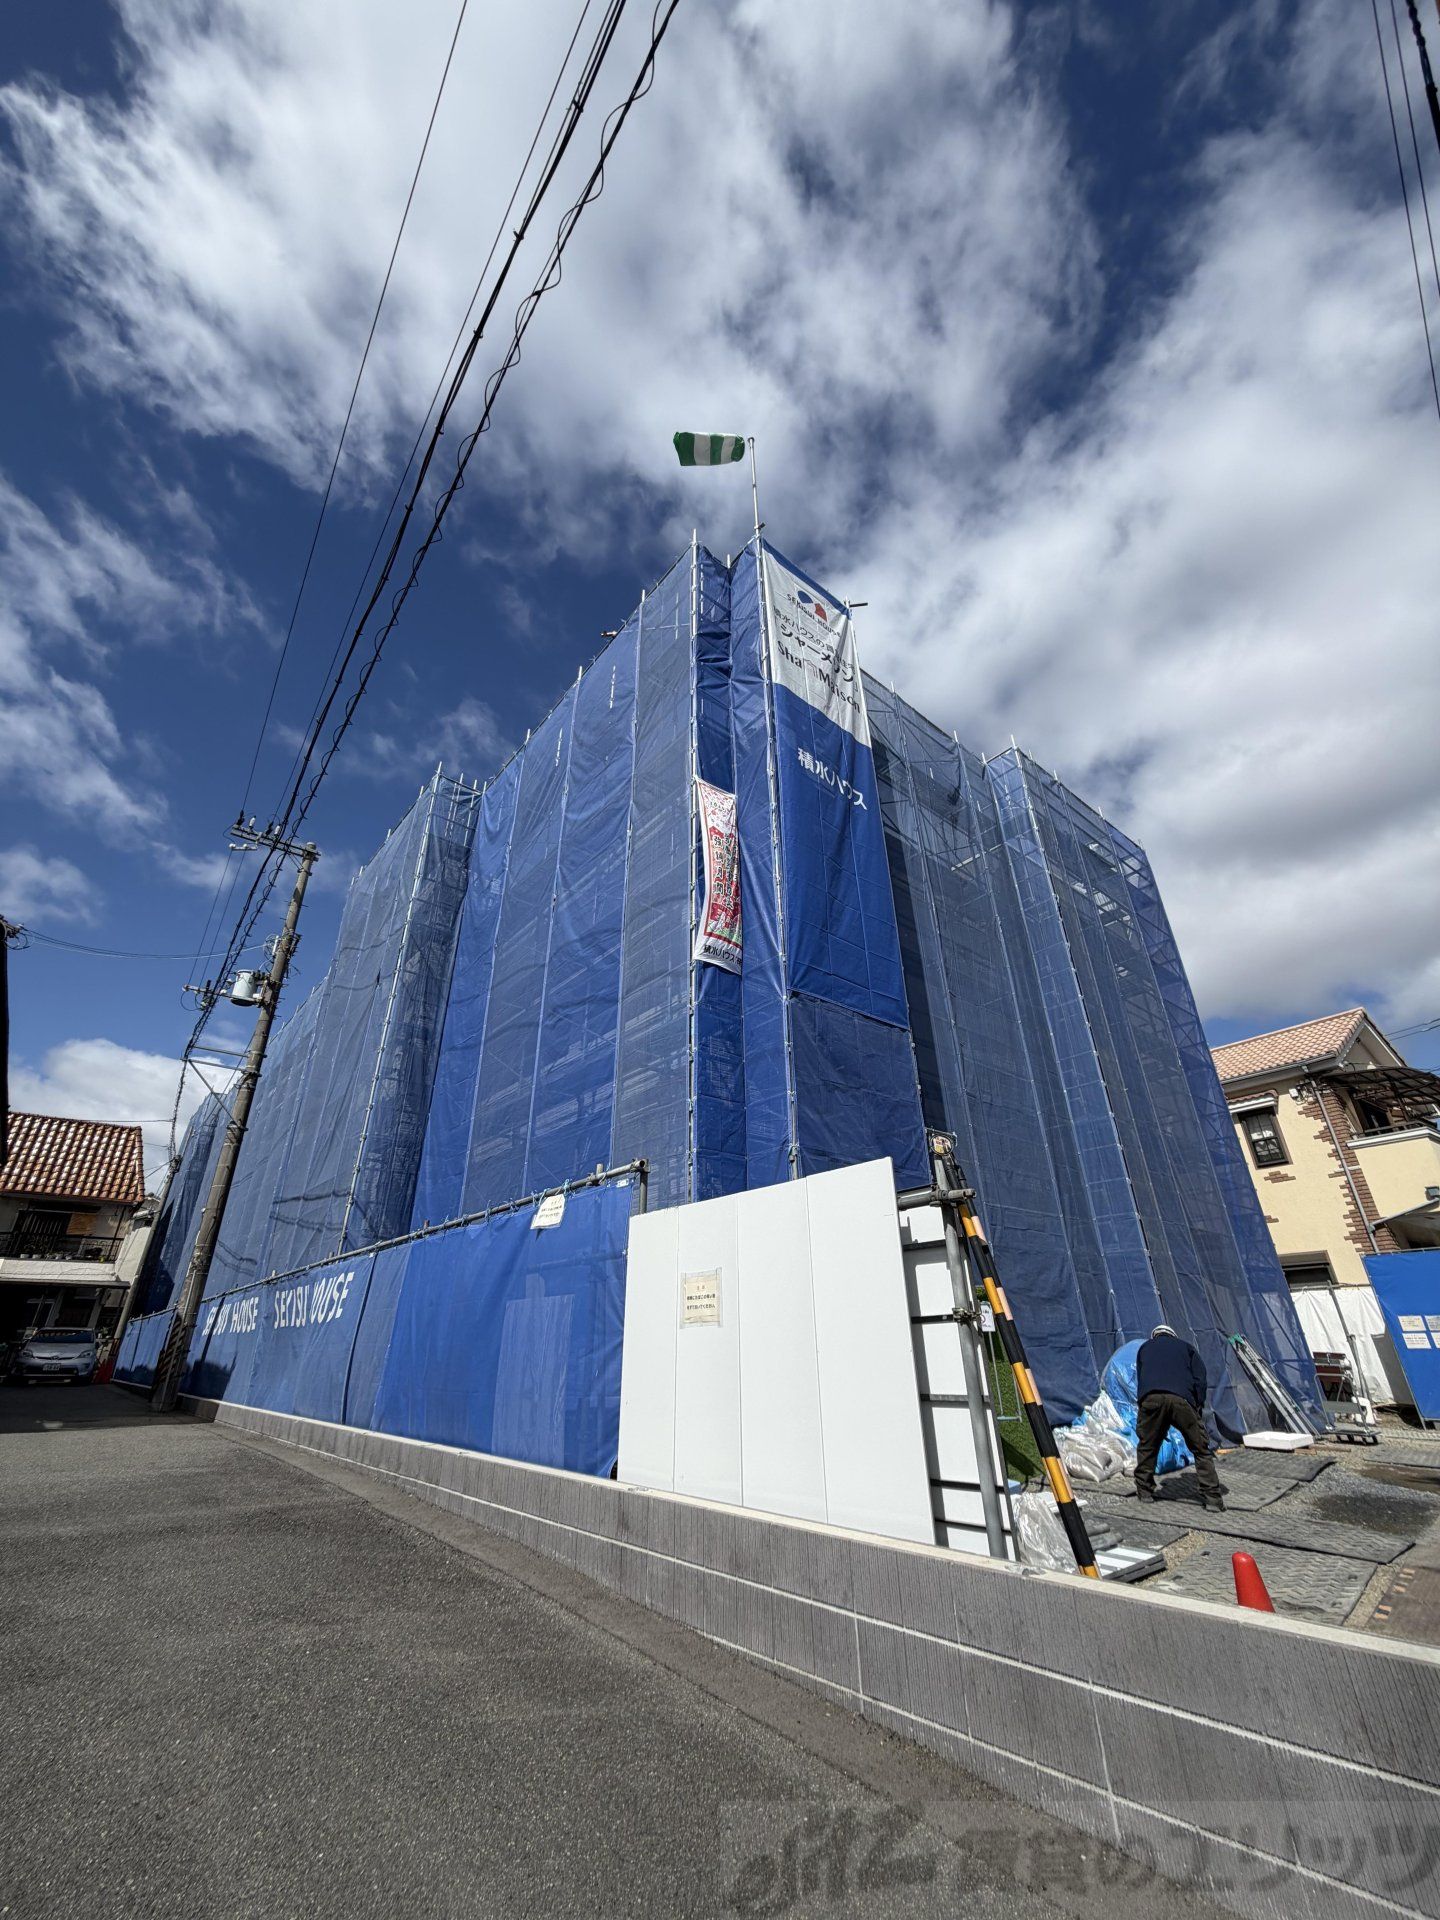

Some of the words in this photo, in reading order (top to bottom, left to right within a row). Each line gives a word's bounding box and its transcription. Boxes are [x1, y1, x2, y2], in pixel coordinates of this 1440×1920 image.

[787, 594, 814, 620] SEKISUI
[817, 617, 841, 638] HOUSE
[777, 641, 802, 669] Sha
[818, 668, 861, 714] Maison
[798, 748, 868, 810] 積水ハウス
[229, 1296, 259, 1334] HOUSE
[274, 1284, 309, 1329] SEKIS
[309, 1271, 354, 1325] OUSE
